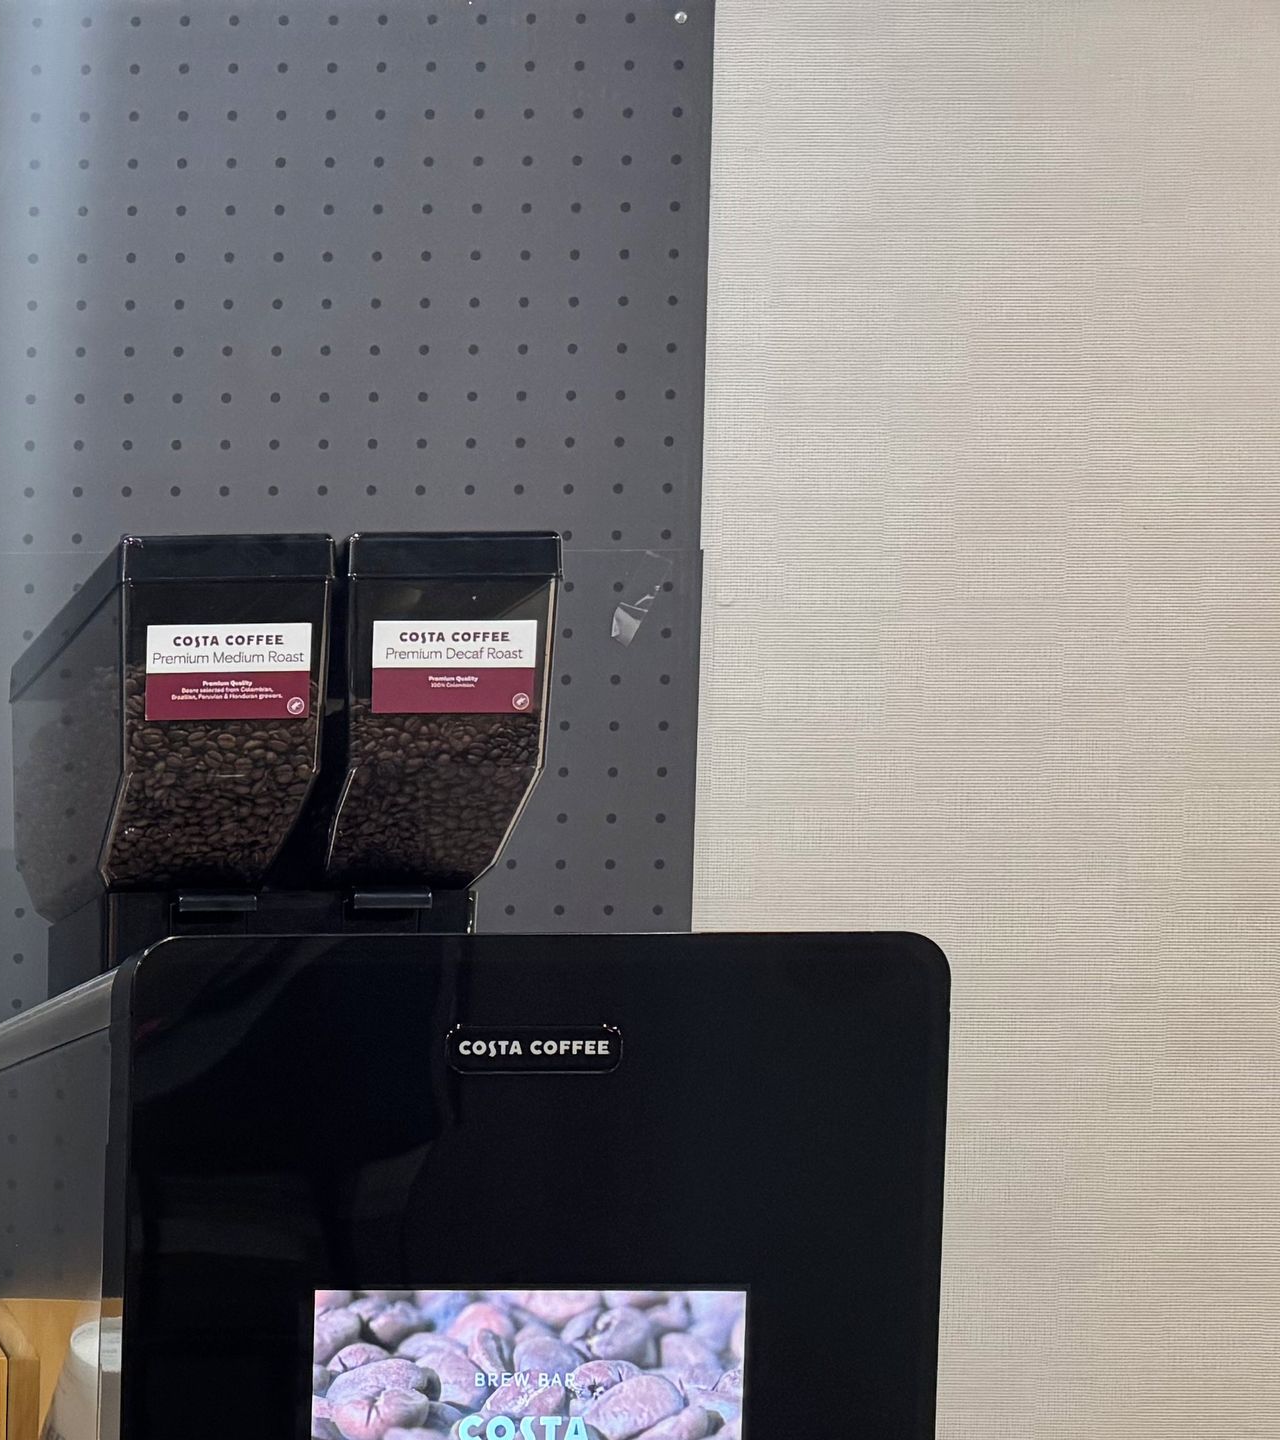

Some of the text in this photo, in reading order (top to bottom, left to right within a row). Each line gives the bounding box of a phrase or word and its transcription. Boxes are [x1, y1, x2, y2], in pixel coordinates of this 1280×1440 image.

[173, 634, 284, 648] COSTA COFFEE
[399, 631, 510, 644] COSTA COFFEE
[153, 650, 304, 664] Premium Medium Roast
[386, 647, 523, 659] Premium Decaf Roast
[458, 1040, 610, 1058] COSTA COFFEE
[474, 1372, 576, 1387] BREW BAR
